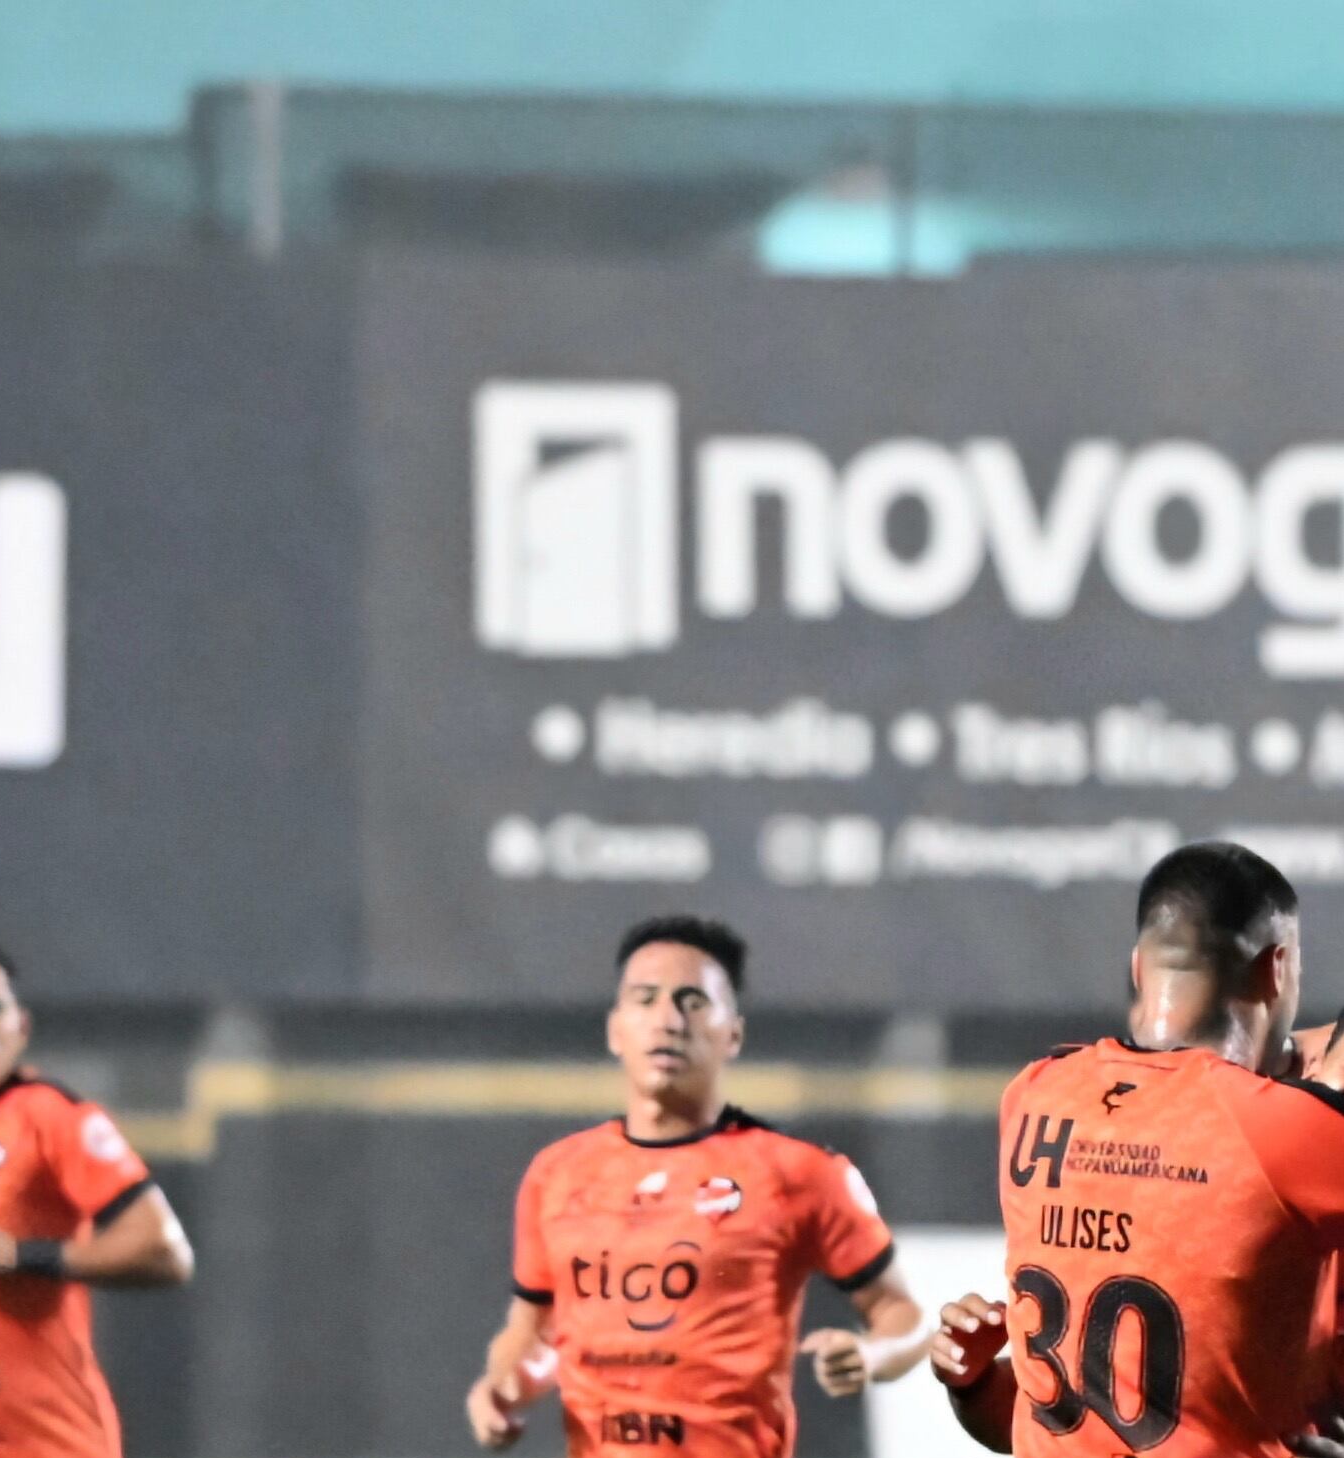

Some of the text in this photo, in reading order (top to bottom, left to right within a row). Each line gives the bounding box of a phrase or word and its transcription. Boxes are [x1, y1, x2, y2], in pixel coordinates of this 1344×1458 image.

[1040, 1204, 1133, 1253] ULISES
[571, 1244, 701, 1331] tigo
[1012, 1264, 1186, 1453] 30
